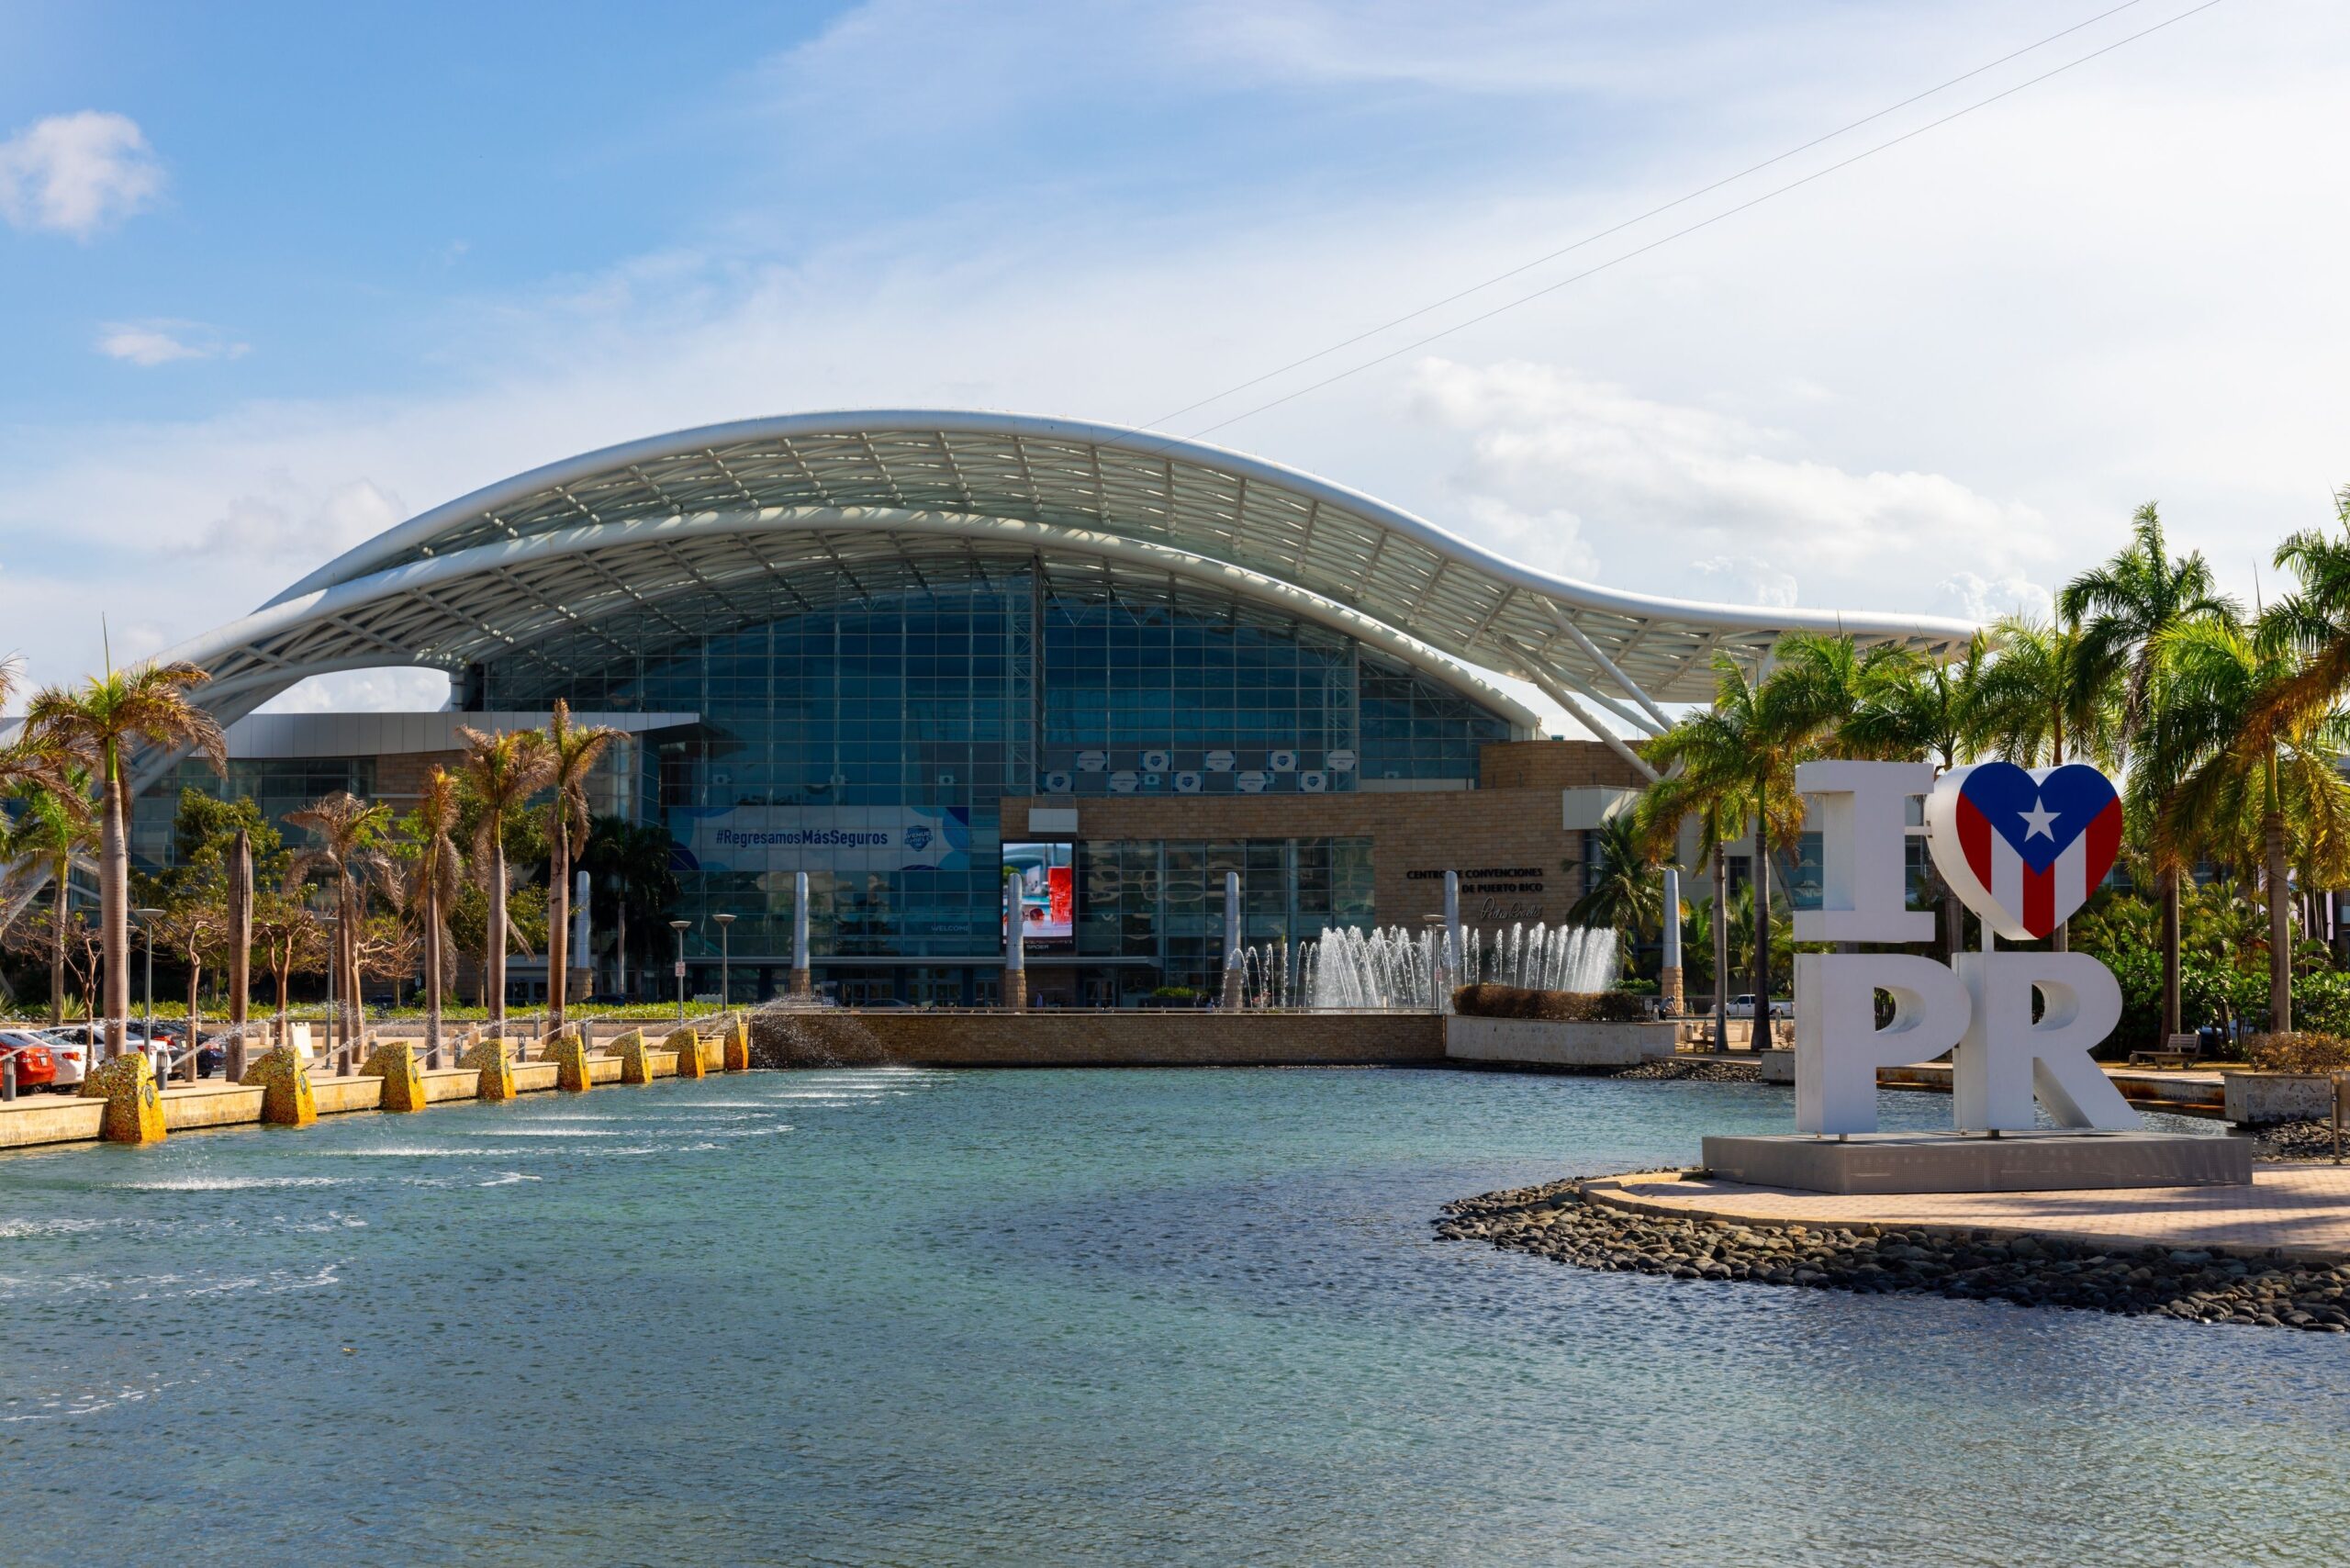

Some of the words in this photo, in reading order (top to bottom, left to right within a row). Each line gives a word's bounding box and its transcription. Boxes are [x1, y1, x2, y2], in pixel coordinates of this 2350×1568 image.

[716, 829, 889, 848] #RegresamosMásSeguros
[1793, 760, 1935, 942] I
[1465, 868, 1543, 879] CONVENCIONES
[1461, 884, 1474, 893] DE
[1477, 883, 1516, 893] PUERTO
[1518, 882, 1543, 892] RICO
[1794, 952, 2143, 1135] PR
